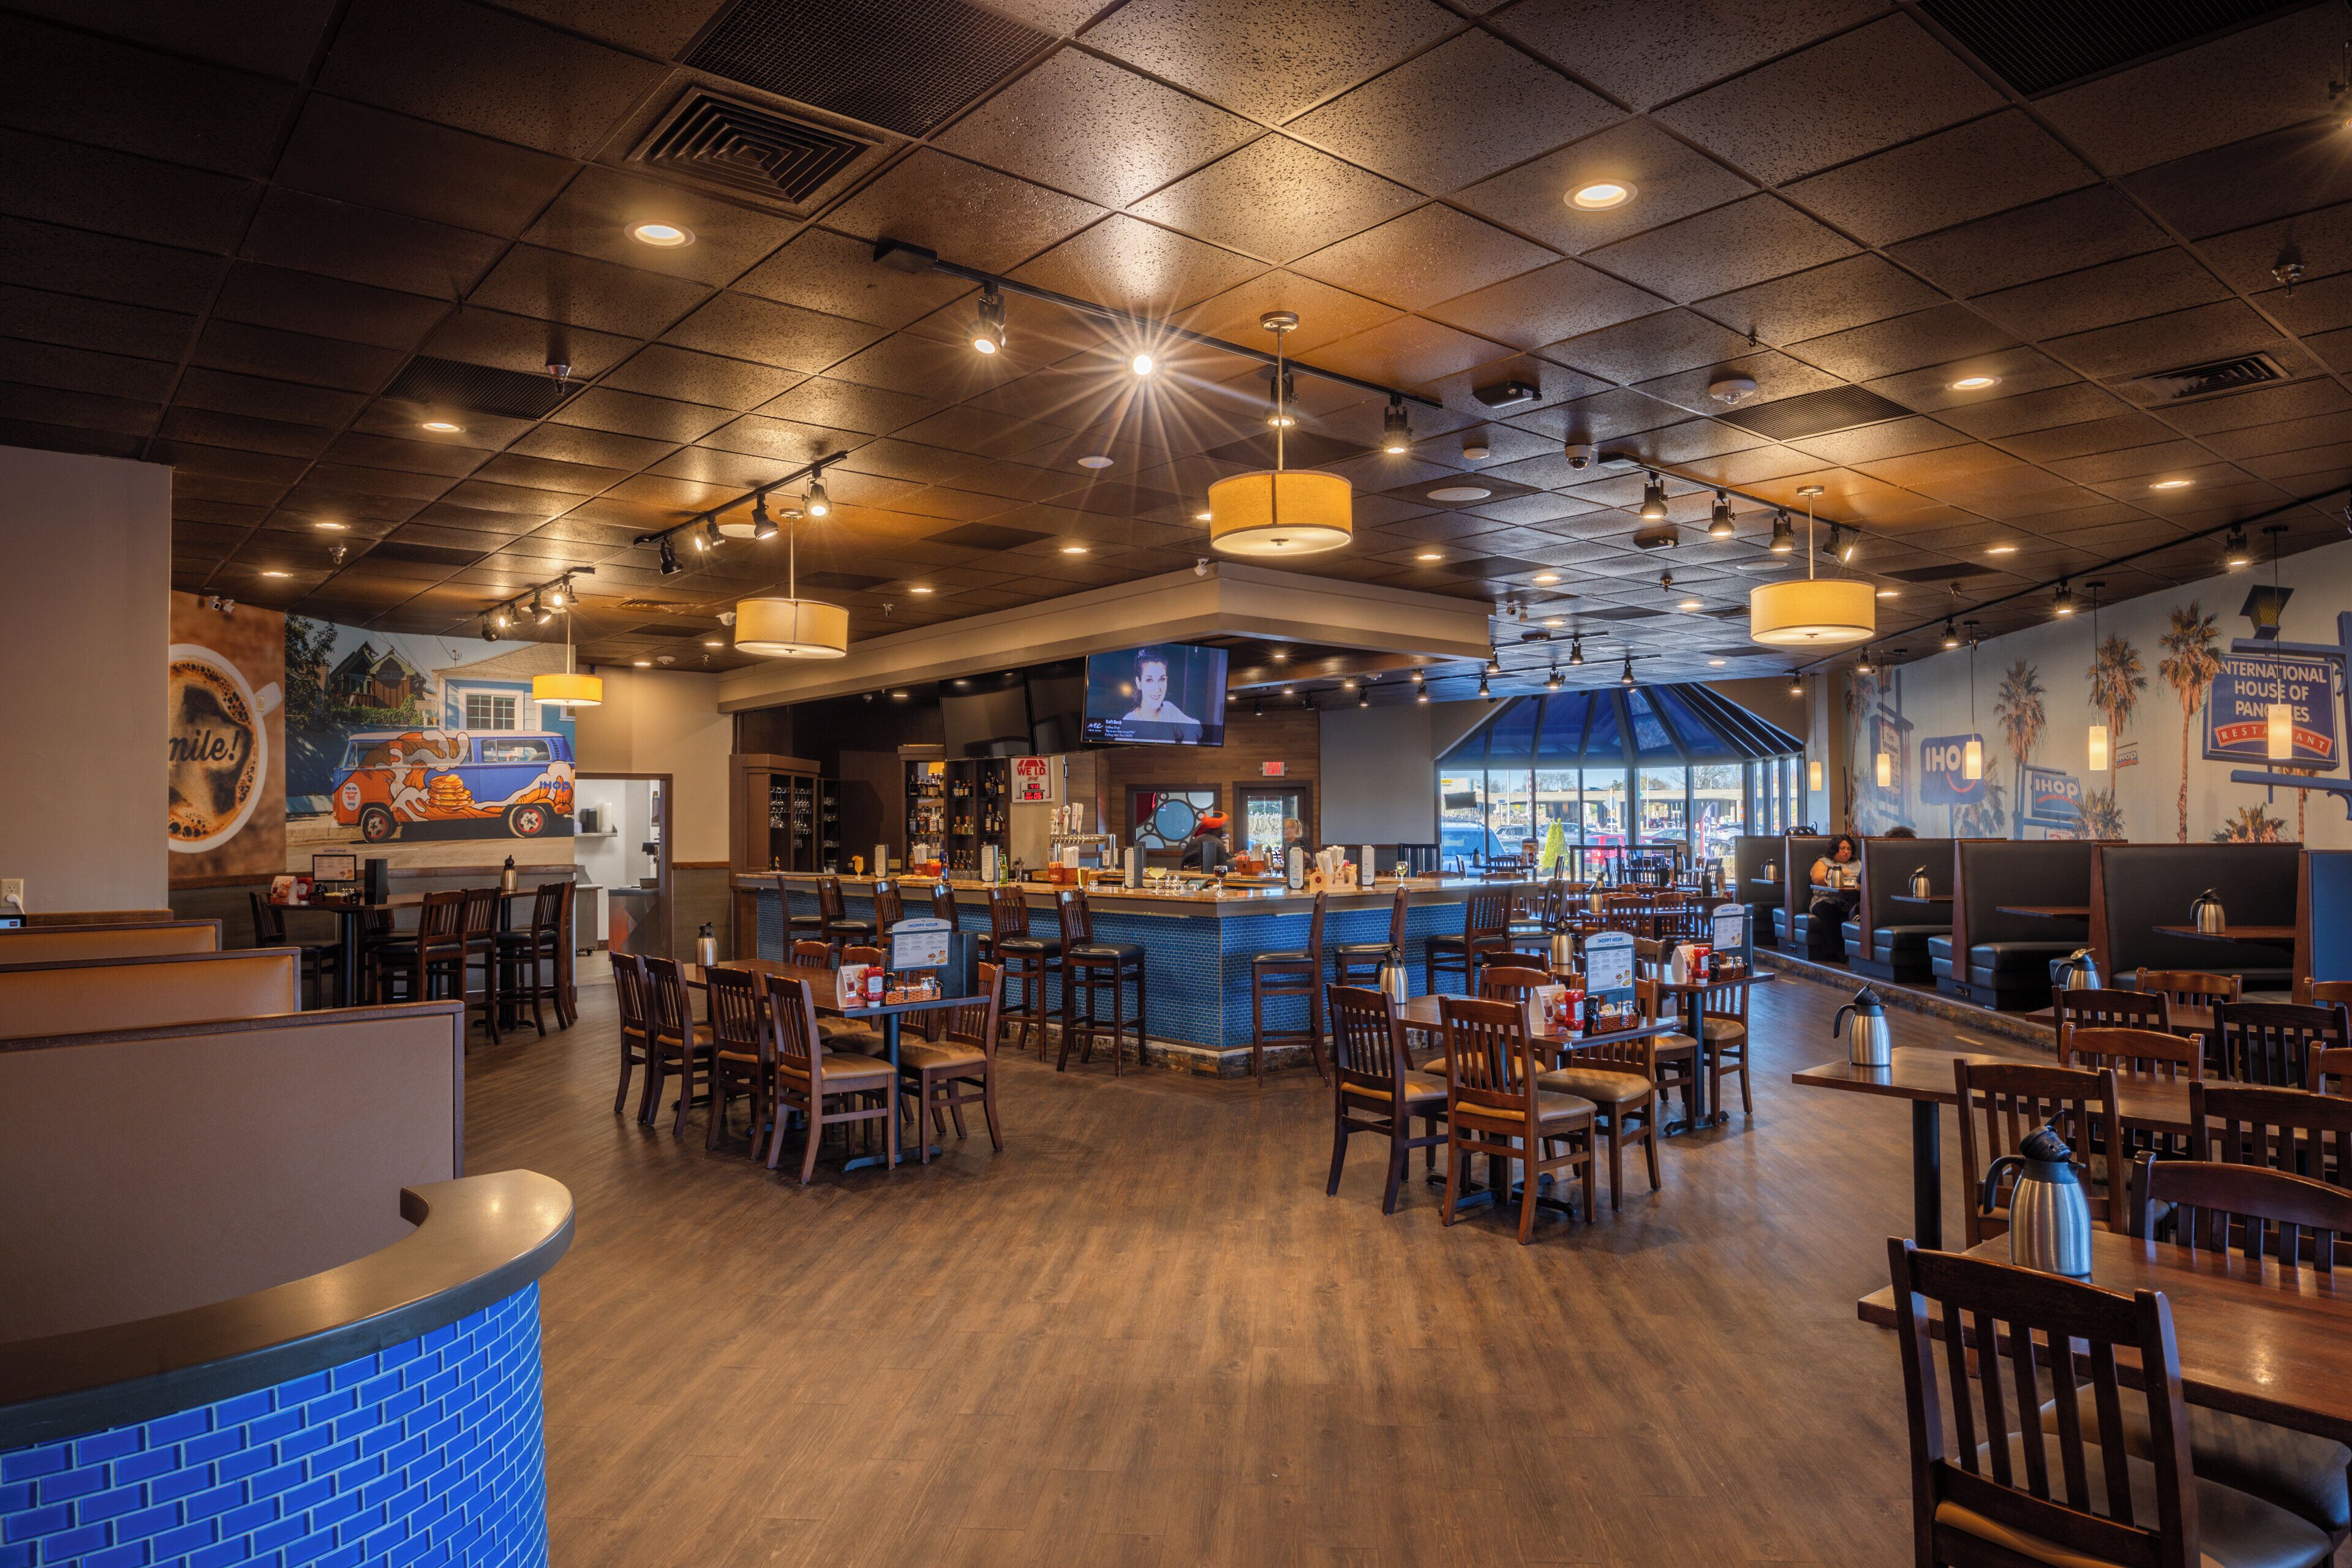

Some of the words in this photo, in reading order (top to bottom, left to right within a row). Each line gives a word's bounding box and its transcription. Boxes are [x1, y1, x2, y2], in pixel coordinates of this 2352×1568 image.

[2234, 680, 2286, 699] HOUSE
[2290, 684, 2309, 701] OF
[2222, 726, 2326, 749] RESTAANT
[2117, 752, 2136, 762] IHOP
[1017, 767, 1032, 775] WE
[1035, 767, 1047, 775] I.D.
[1266, 762, 1281, 775] EXIT
[2035, 778, 2079, 799] IHOP
